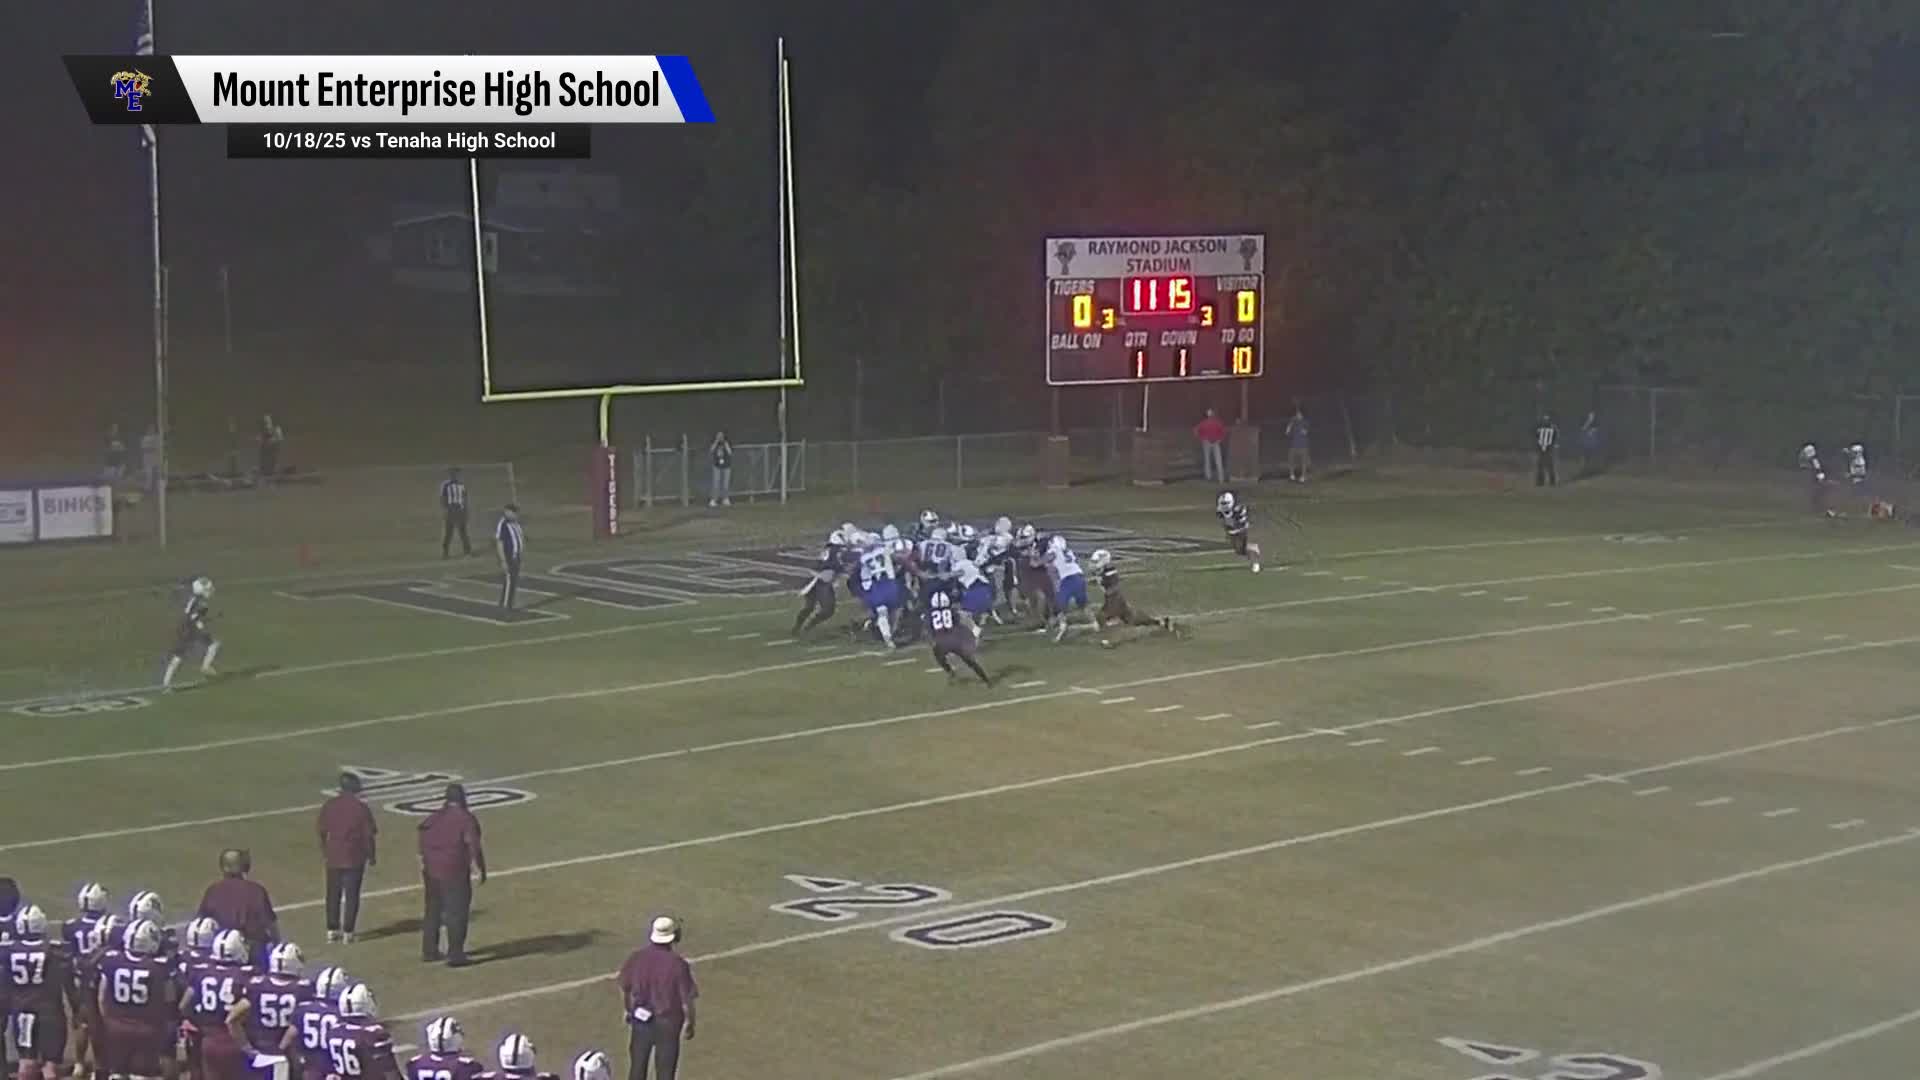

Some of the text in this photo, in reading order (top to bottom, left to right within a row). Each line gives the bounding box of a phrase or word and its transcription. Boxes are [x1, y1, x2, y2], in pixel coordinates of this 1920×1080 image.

[1088, 238, 1227, 256] RAYMOND JACKSON
[1127, 258, 1191, 273] STADIUM
[1054, 280, 1095, 295] TIGERS
[1073, 294, 1092, 328] 0
[1200, 305, 1213, 326] 3
[1237, 290, 1254, 322] 0
[1101, 308, 1114, 329] 3
[1051, 332, 1102, 350] BALL ON
[1161, 330, 1197, 346] DOWN
[1222, 328, 1255, 343] TO GO
[1137, 351, 1144, 377] 1
[1179, 349, 1187, 376] 1
[1233, 346, 1252, 374] 10
[931, 609, 953, 630] 28
[10, 952, 46, 984] 57
[114, 967, 149, 1004] 65
[260, 993, 296, 1028] 52
[329, 1037, 361, 1076] 56
